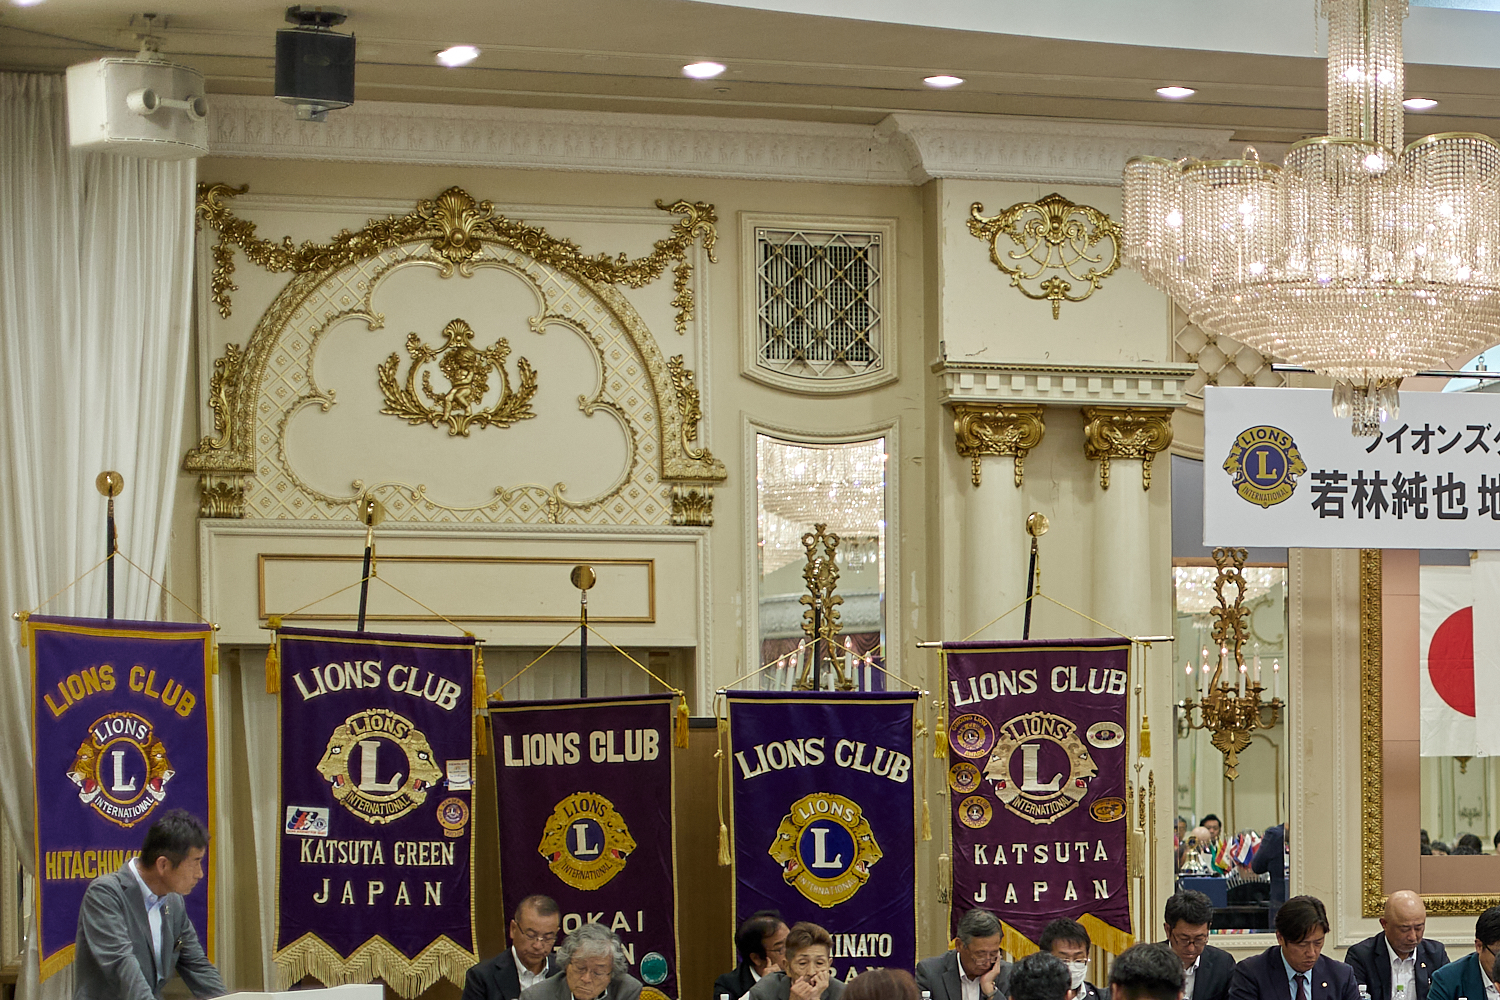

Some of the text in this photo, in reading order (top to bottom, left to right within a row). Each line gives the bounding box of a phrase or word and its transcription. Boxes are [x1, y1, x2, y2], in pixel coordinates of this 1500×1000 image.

[1241, 428, 1289, 446] LIONS
[1256, 450, 1277, 479] L
[1241, 485, 1289, 502] INTERNATIONAL
[1310, 469, 1469, 520] 若林純也
[43, 664, 197, 717] LIONS CLUB
[292, 660, 462, 711] LIONS CLUB
[950, 665, 1127, 707] LIONS CLUB
[94, 718, 148, 742] LIONS
[351, 715, 409, 737] LIONS
[1009, 716, 1070, 742] LIONS
[503, 728, 660, 767] LIONS CLUB
[734, 737, 912, 783] LIONS CLUB
[111, 750, 136, 791] L
[358, 740, 403, 792] L
[1020, 743, 1063, 792] L
[94, 796, 155, 818] INTERNATIONAL
[345, 791, 411, 815] INTERNATIONAL
[562, 798, 608, 819] LIONS
[798, 799, 855, 823] LIONS
[1012, 796, 1072, 816] INTERNATIONAL
[300, 838, 455, 866] KATSUTA GREEN
[572, 823, 599, 856] L
[810, 827, 843, 869] L
[974, 839, 1108, 866] KATSUTA
[45, 850, 142, 879] HITACHIN
[561, 862, 613, 880] INTERNATIONAL
[313, 878, 442, 906] JAPAN
[797, 875, 858, 896] INTERNATIONAL
[974, 879, 1110, 904] JAPAN
[562, 910, 643, 936] OKAI
